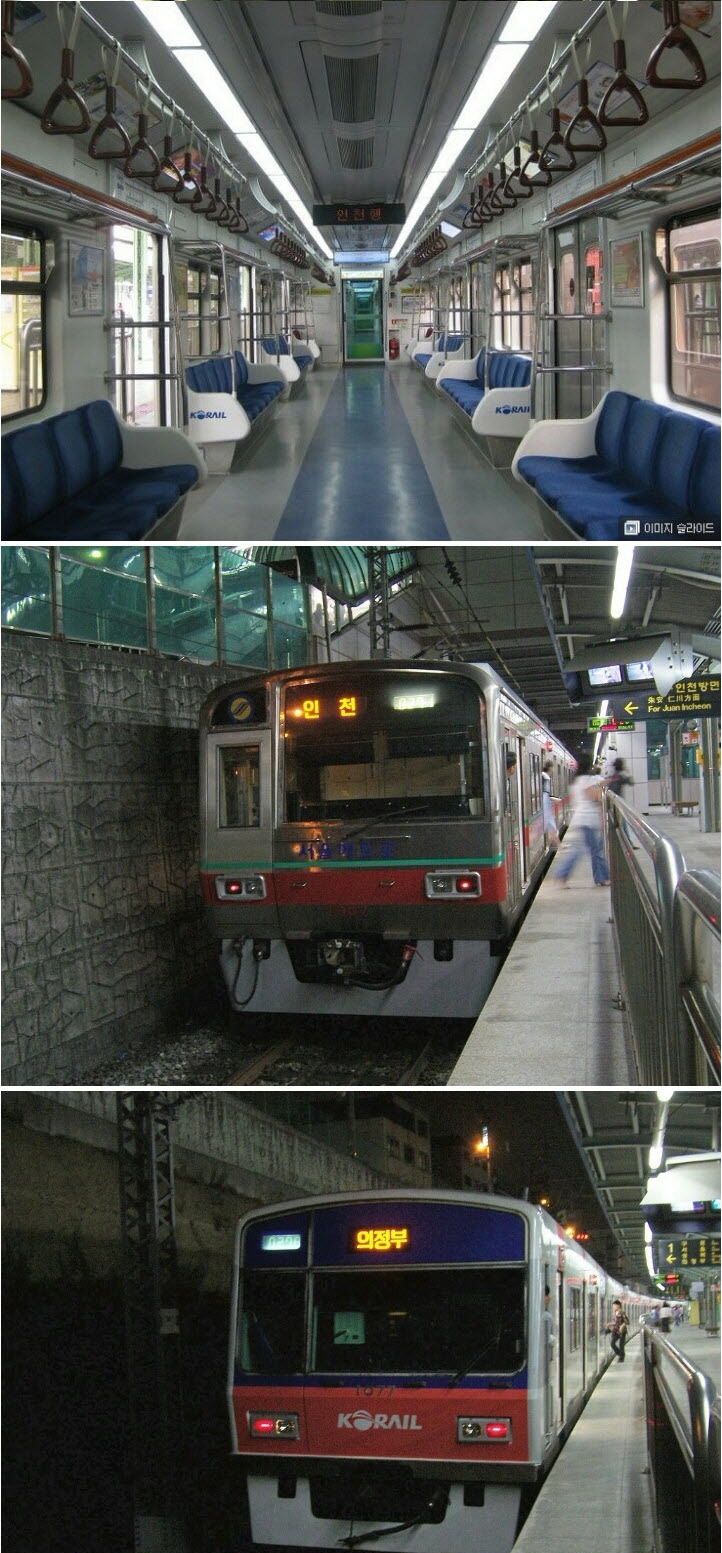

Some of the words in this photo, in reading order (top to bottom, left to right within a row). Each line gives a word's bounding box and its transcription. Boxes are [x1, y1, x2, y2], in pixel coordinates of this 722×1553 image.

[336, 208, 382, 222] 인천행
[190, 410, 227, 420] KORAIL
[676, 681, 720, 693] 인천방면
[667, 693, 700, 703] 仁川方面
[648, 705, 661, 713] For
[662, 704, 681, 712] Juan
[681, 703, 712, 711] Incheon
[356, 1228, 408, 1250] 의정부
[337, 1410, 423, 1431] KORAIL
